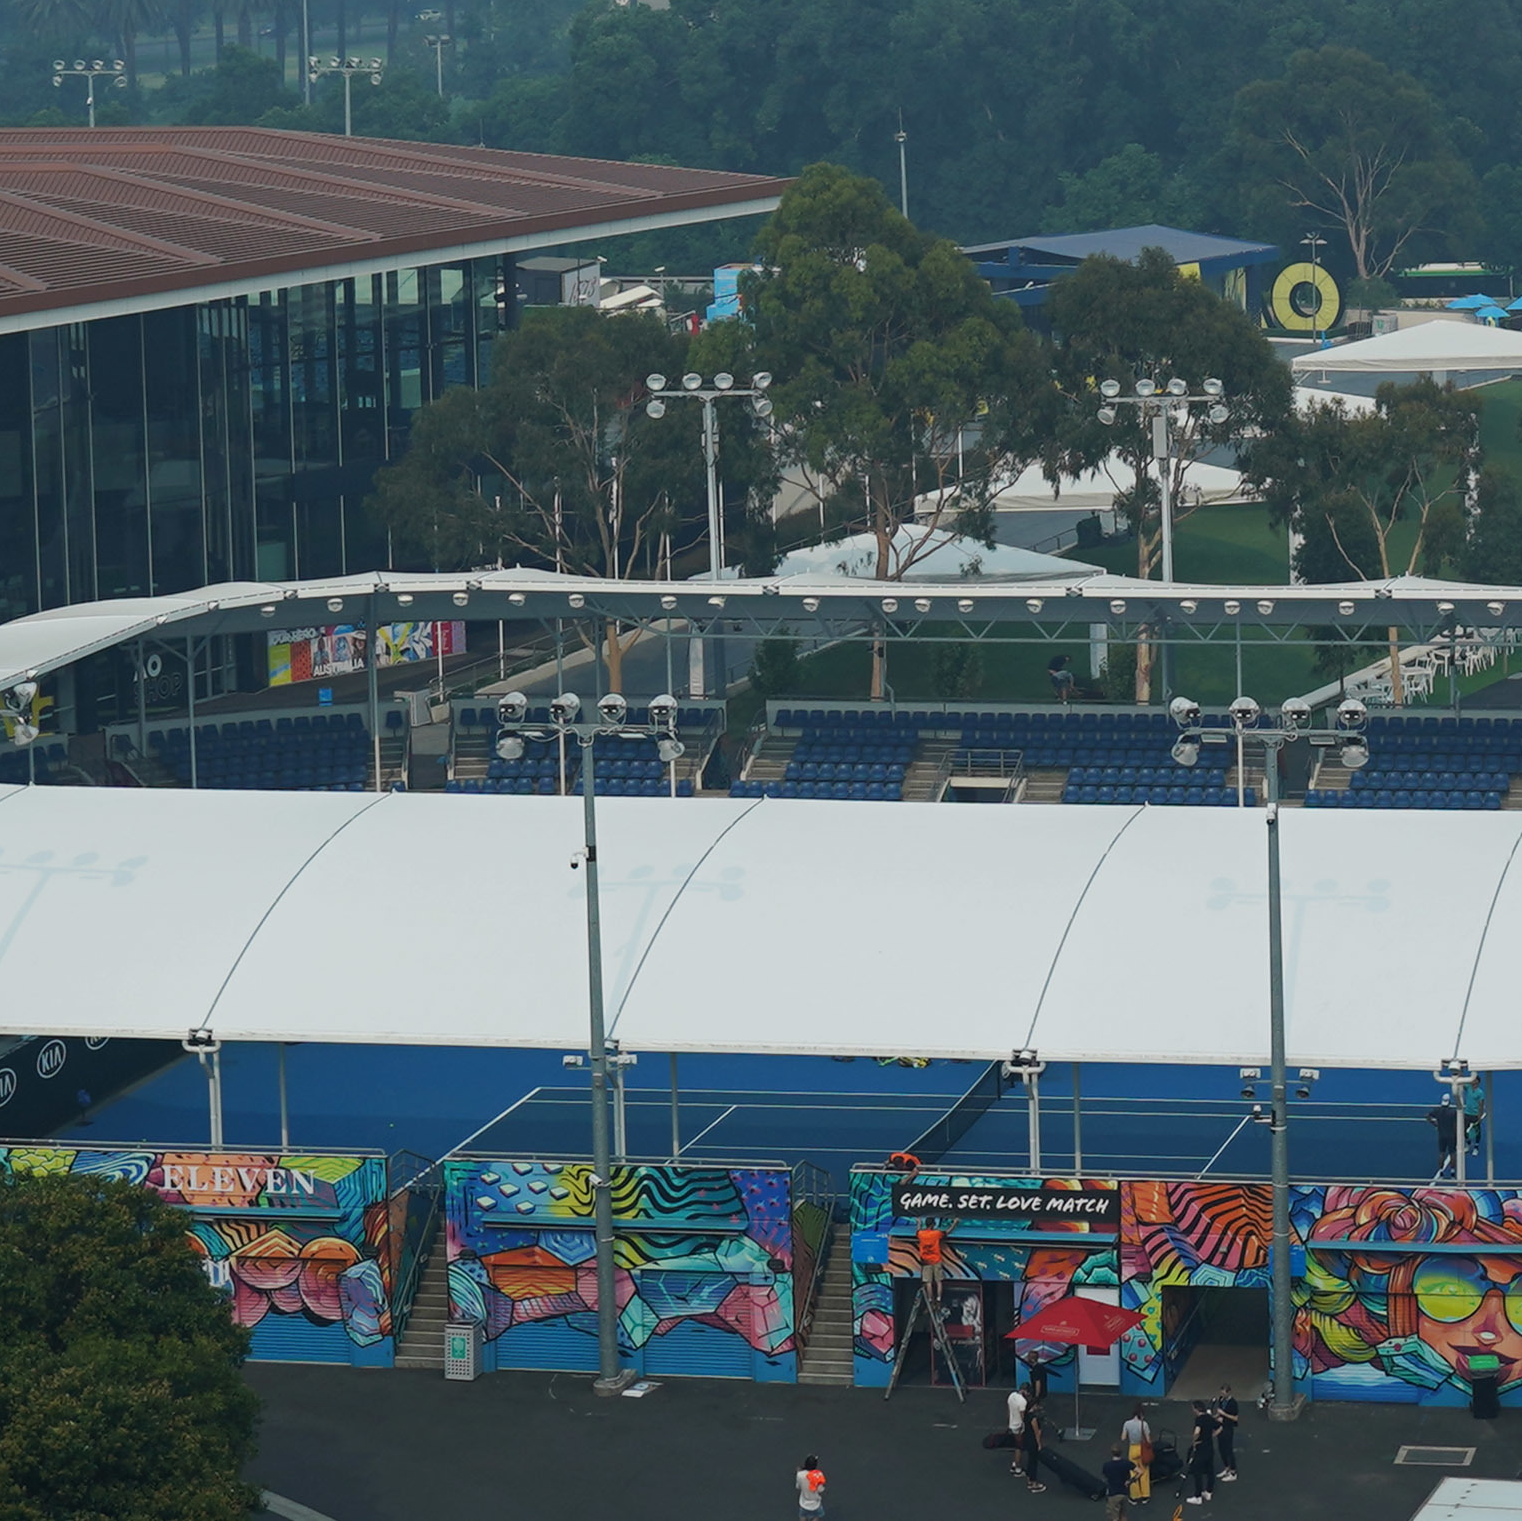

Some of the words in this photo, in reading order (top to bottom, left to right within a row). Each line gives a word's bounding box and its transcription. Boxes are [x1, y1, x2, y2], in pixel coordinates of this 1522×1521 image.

[161, 1164, 315, 1195] ELEVEN
[899, 1192, 954, 1211] GAME.
[957, 1194, 992, 1212] SET.
[995, 1195, 1042, 1212] LOVE
[1045, 1197, 1110, 1215] MATCH
